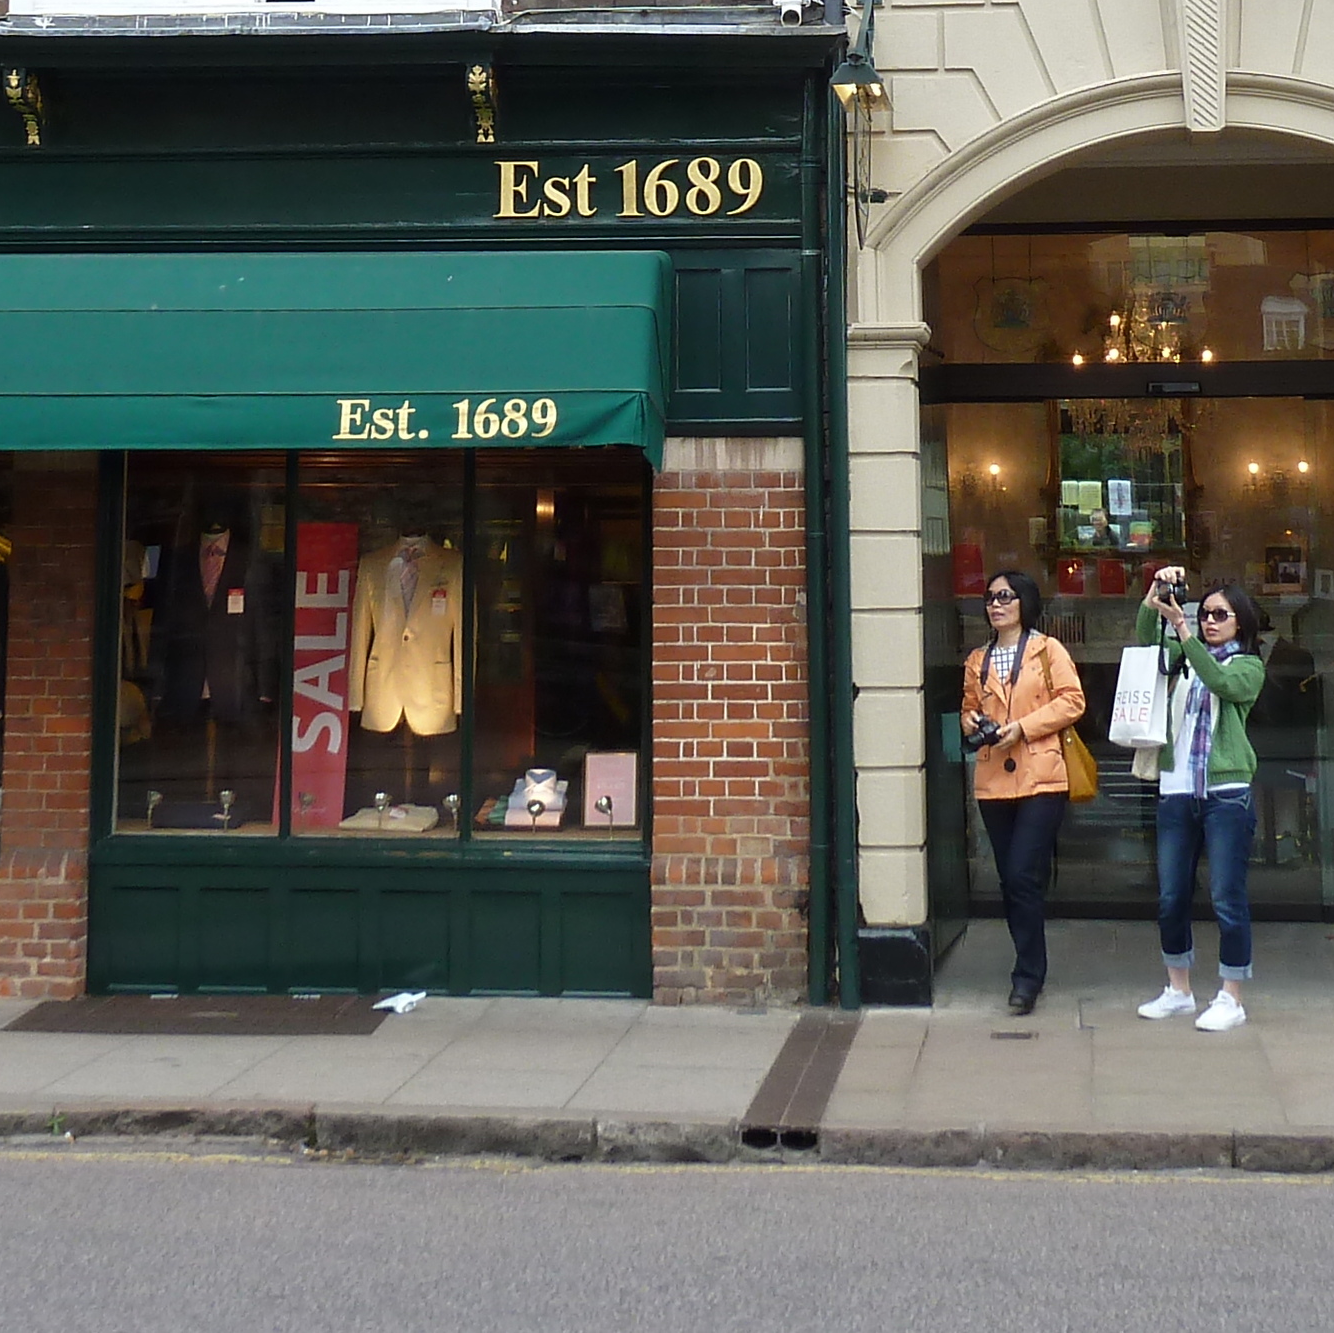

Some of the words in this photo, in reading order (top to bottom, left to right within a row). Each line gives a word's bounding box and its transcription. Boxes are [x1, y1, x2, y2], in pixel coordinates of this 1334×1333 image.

[493, 160, 598, 218] Est
[614, 157, 764, 217] 1689
[332, 399, 429, 440] Est.
[451, 397, 557, 439] 1689
[291, 569, 350, 754] SALE
[1113, 707, 1149, 722] SALE
[1116, 690, 1151, 704] REISS
